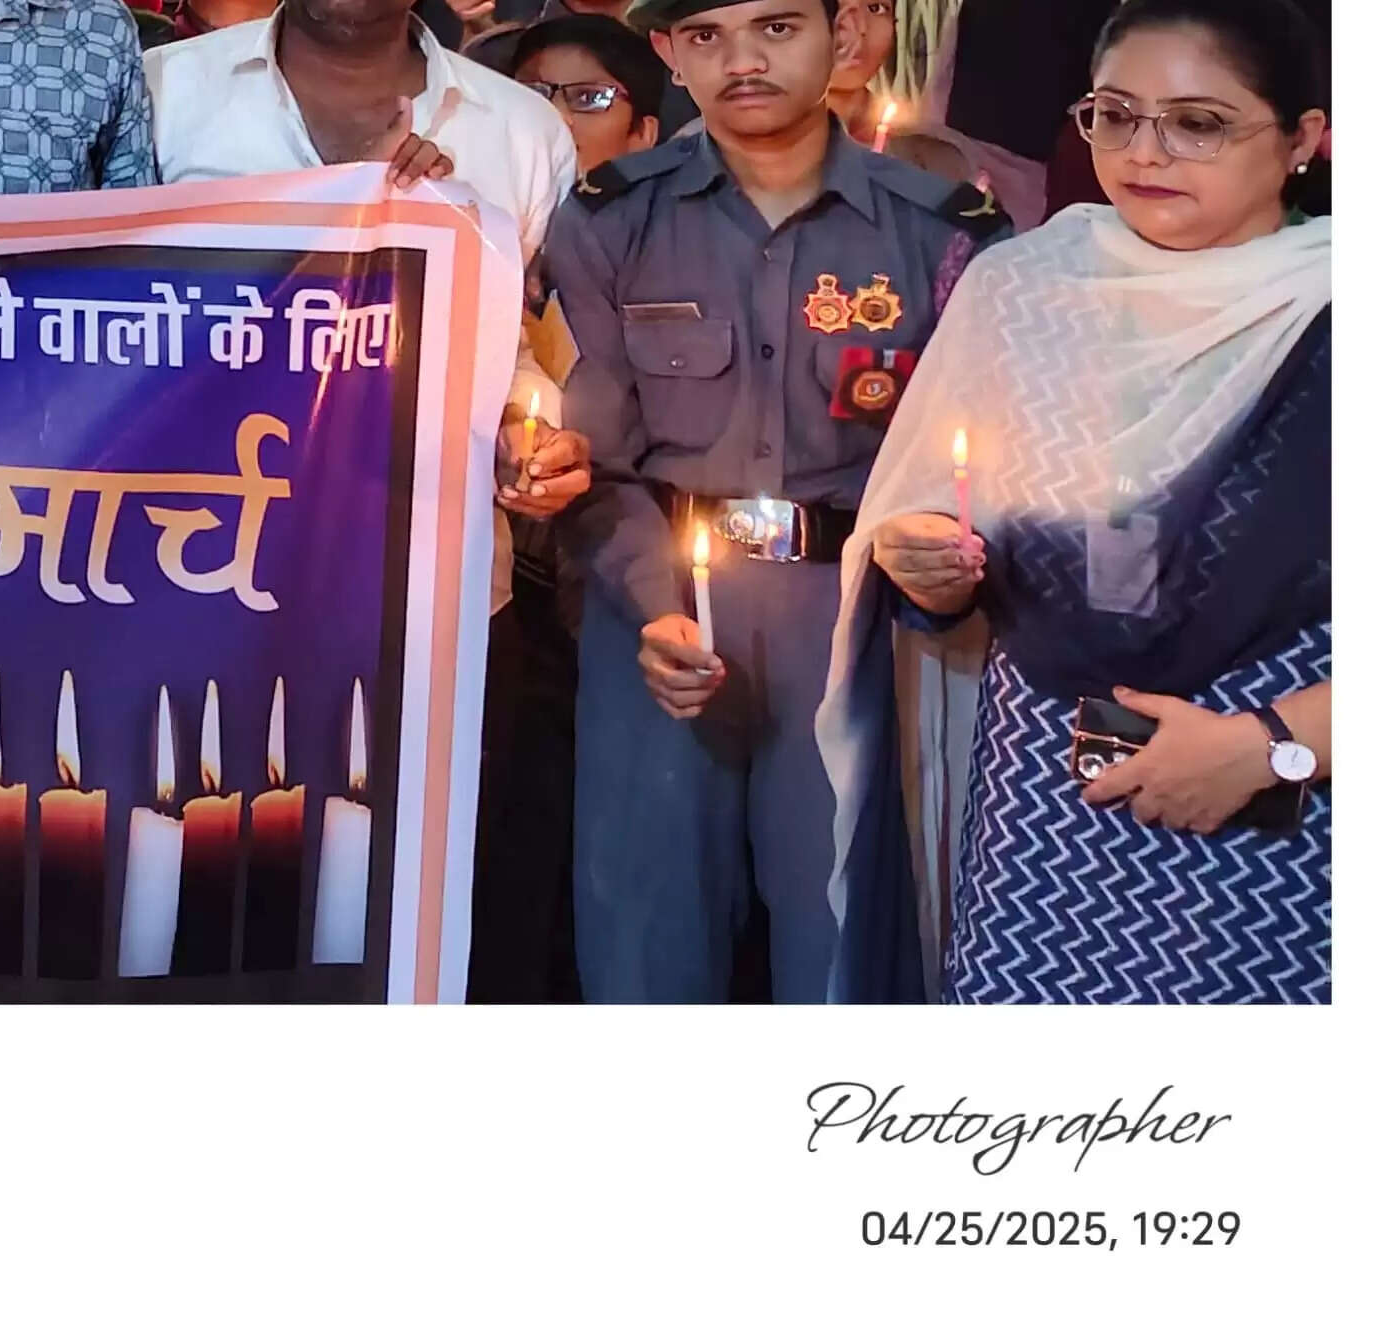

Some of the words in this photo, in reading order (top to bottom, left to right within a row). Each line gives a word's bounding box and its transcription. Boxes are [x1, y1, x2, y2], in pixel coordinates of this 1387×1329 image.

[33, 281, 202, 369] वालों
[203, 284, 273, 372] के
[284, 288, 394, 373] लिए
